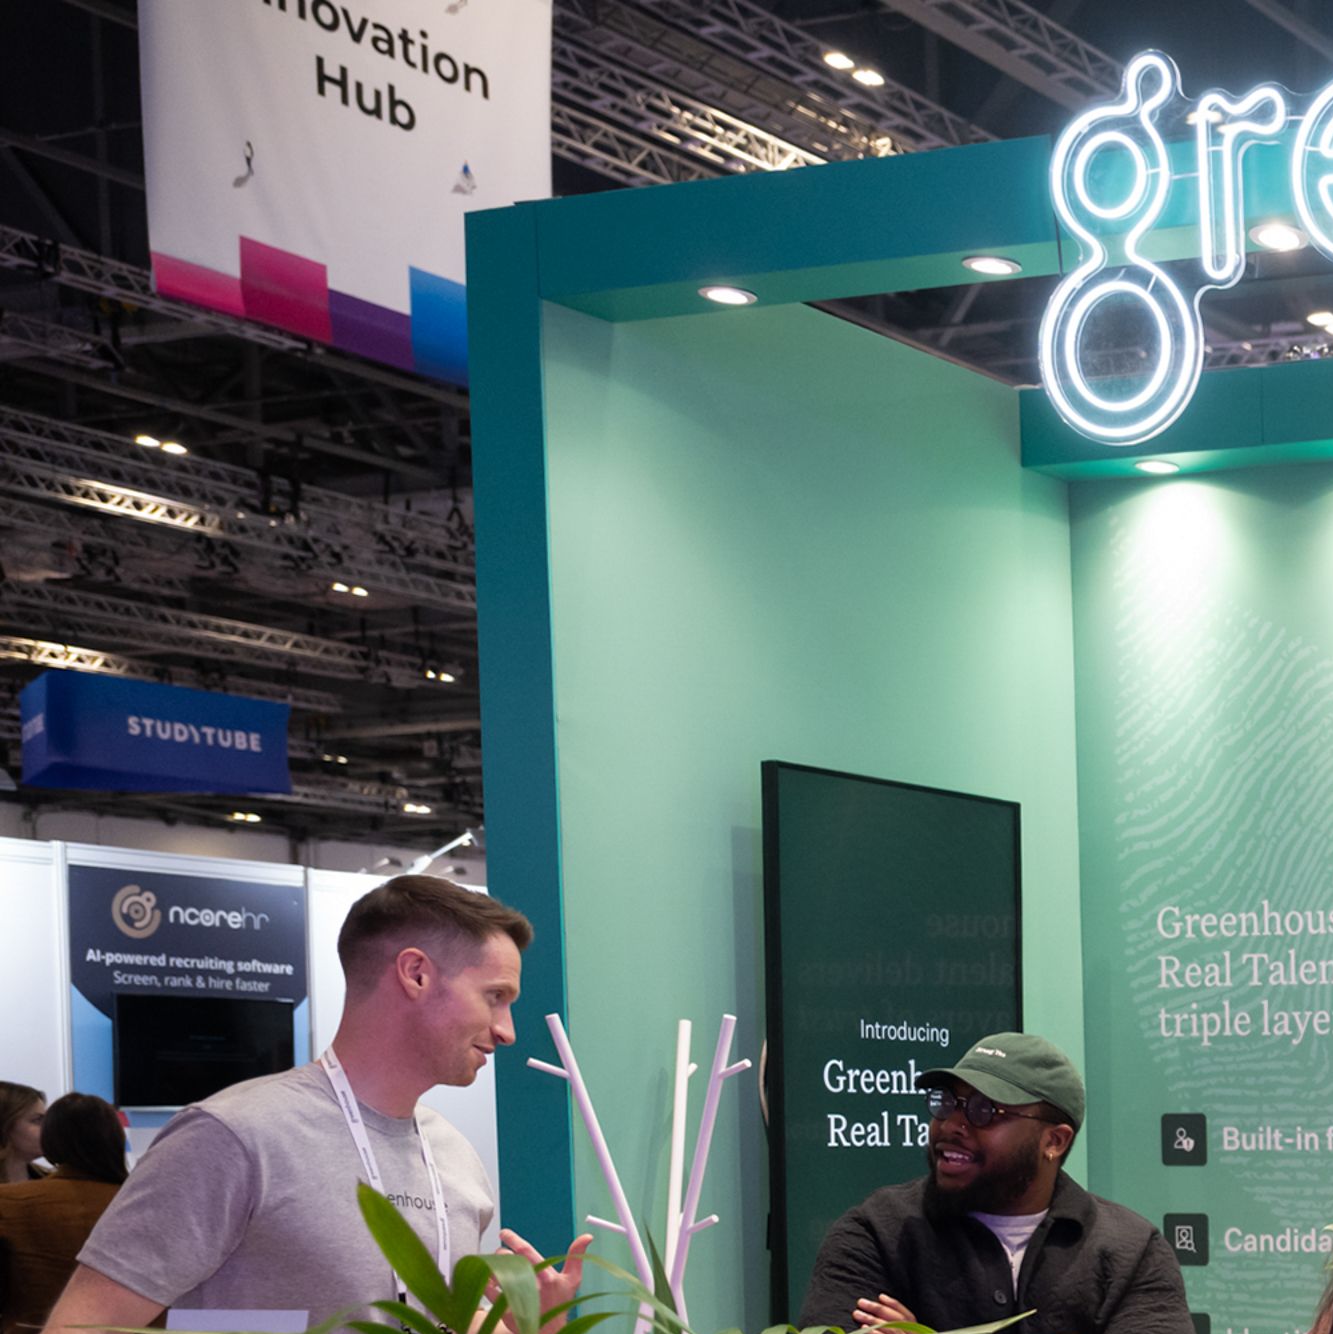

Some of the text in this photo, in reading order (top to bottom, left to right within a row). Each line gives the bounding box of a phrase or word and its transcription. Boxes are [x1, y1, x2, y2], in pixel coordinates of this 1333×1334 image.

[263, 0, 489, 100] ovation
[316, 55, 416, 131] Hub
[86, 949, 294, 975] AI-powered recruiting software
[1158, 952, 1231, 988] Real
[164, 974, 192, 988] rank
[195, 976, 206, 988] &
[208, 975, 232, 990] hire
[235, 977, 271, 992] faster
[860, 1019, 949, 1047] Introducing
[1159, 1002, 1251, 1046] triple
[823, 1059, 930, 1095] Greenh
[827, 1113, 930, 1148] Real Ta
[1223, 1127, 1320, 1151] Built-in
